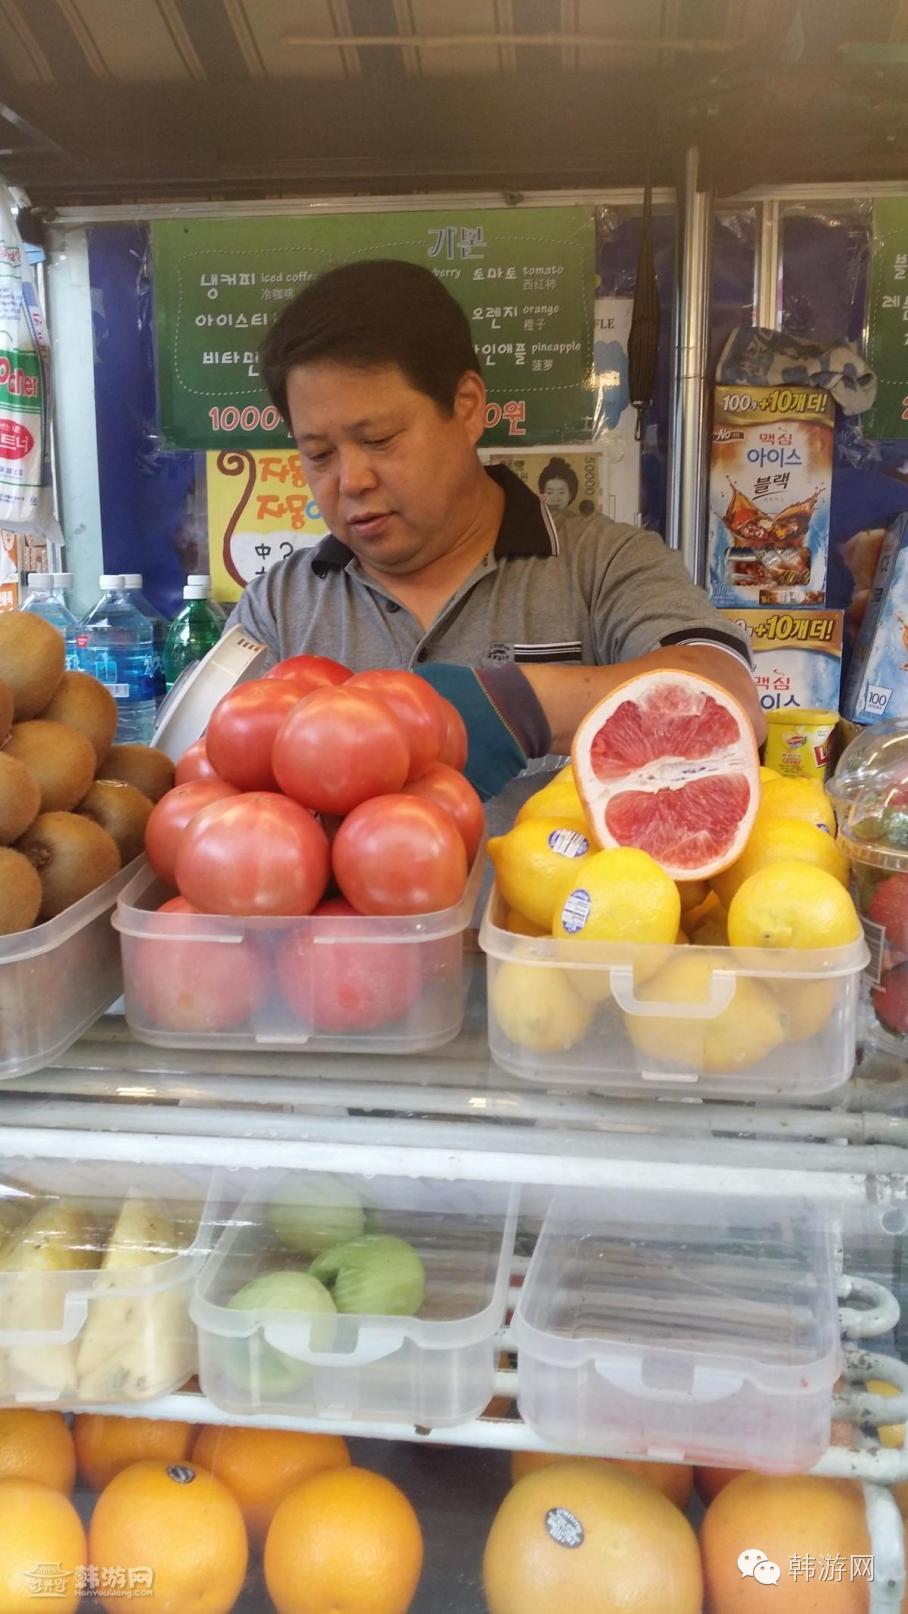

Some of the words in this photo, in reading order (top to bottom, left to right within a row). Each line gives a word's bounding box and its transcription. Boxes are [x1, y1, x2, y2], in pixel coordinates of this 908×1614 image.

[427, 226, 486, 260] 기본
[261, 272, 283, 282] iced
[472, 267, 518, 281] 토마토
[523, 265, 564, 275] tomato
[200, 272, 255, 299] 냉커피
[472, 305, 518, 329] 오렌지
[523, 305, 560, 316] orange
[195, 312, 268, 328] 아이스티
[531, 341, 582, 355] pineapple
[759, 432, 793, 446] 맥심
[747, 447, 803, 468] 아이스
[752, 472, 791, 494] 블랙
[868, 691, 887, 706] 100
